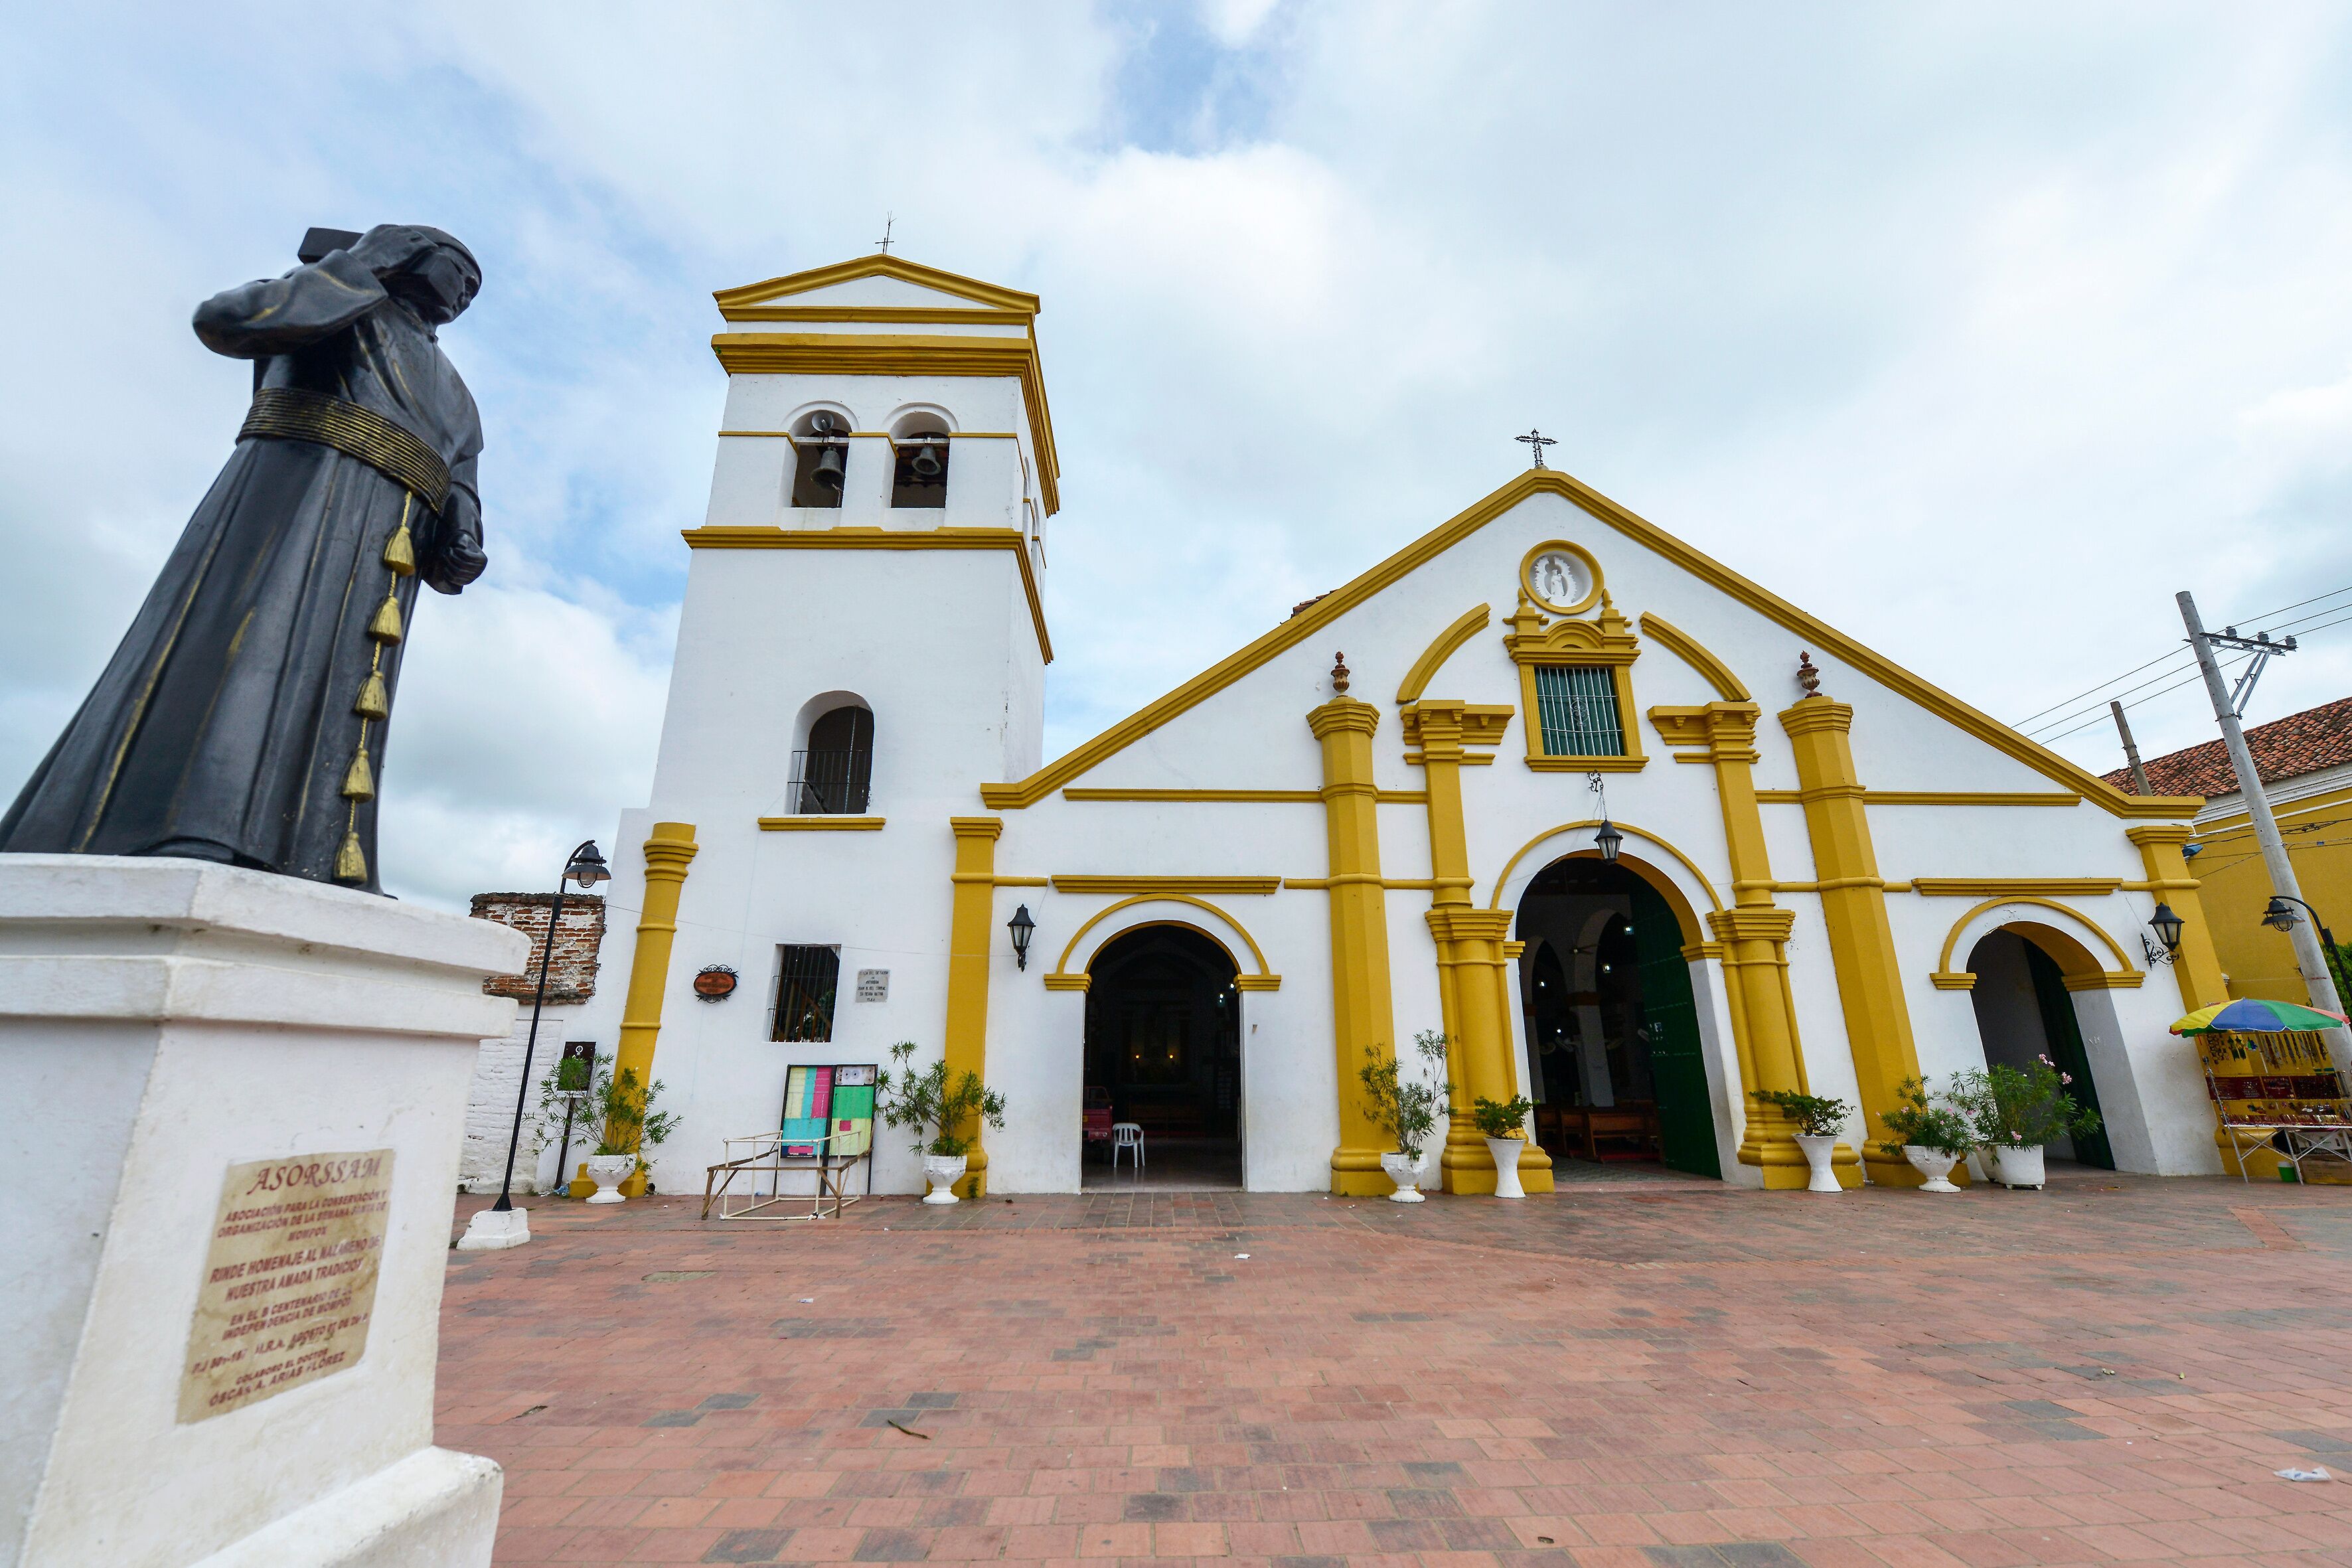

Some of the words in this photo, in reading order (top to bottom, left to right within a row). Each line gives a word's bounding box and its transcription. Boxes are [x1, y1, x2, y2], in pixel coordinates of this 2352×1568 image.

[246, 1157, 381, 1195] ASORSSAM
[284, 1202, 307, 1212] PARA
[309, 1200, 320, 1210] LA
[290, 1215, 303, 1225] DE
[304, 1214, 315, 1223] LA
[210, 1263, 246, 1283] RINDE
[248, 1251, 303, 1274] HOMENAJE
[305, 1249, 317, 1263] AL
[368, 1235, 380, 1249] DE
[226, 1278, 275, 1301] NUESTRA
[277, 1269, 312, 1289] AMADA
[230, 1313, 245, 1326] EN
[247, 1310, 258, 1321] EL
[302, 1306, 315, 1318] DE
[270, 1365, 304, 1385] ARIAS
